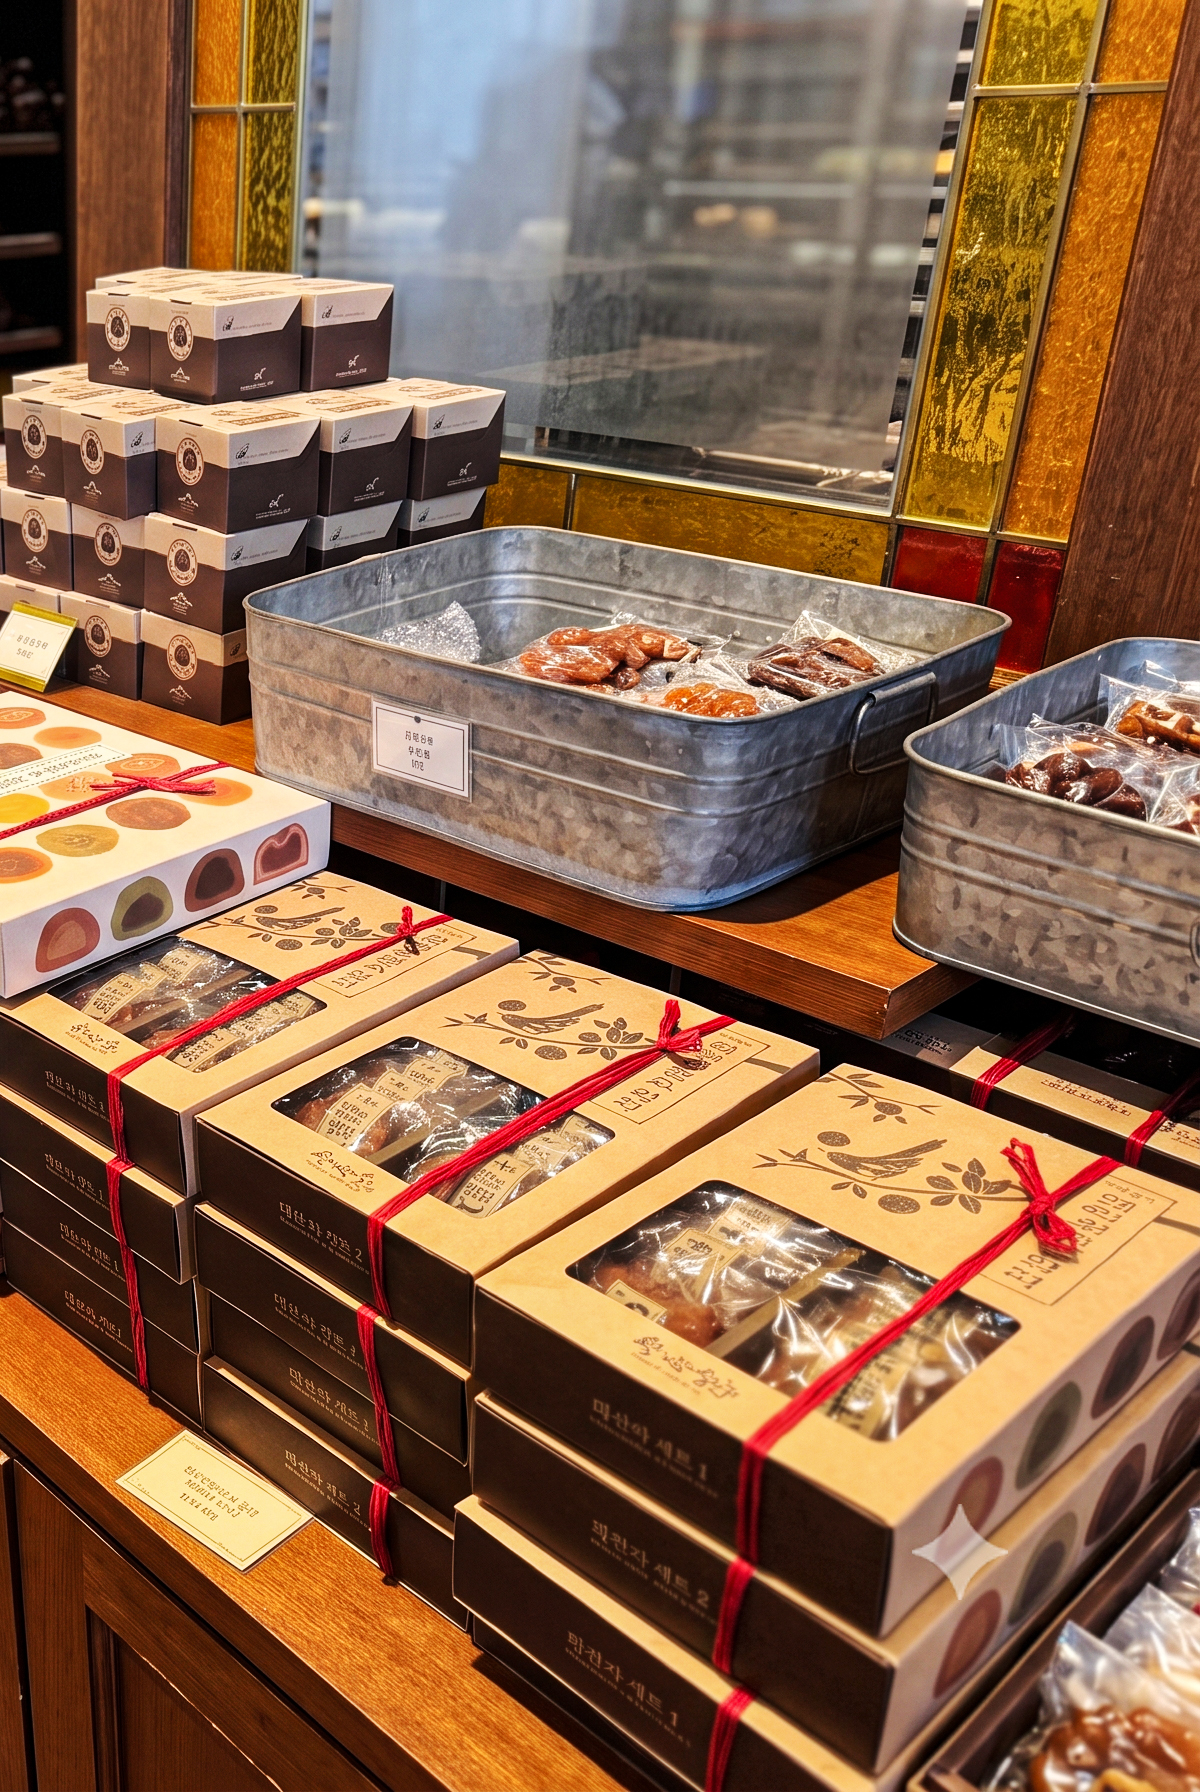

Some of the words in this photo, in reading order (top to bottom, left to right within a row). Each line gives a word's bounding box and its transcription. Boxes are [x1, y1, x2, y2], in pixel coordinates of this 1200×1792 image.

[654, 1563, 692, 1598] 세트
[696, 1589, 710, 1610] 2
[626, 1680, 664, 1715] 세트
[670, 1711, 678, 1728] 1
